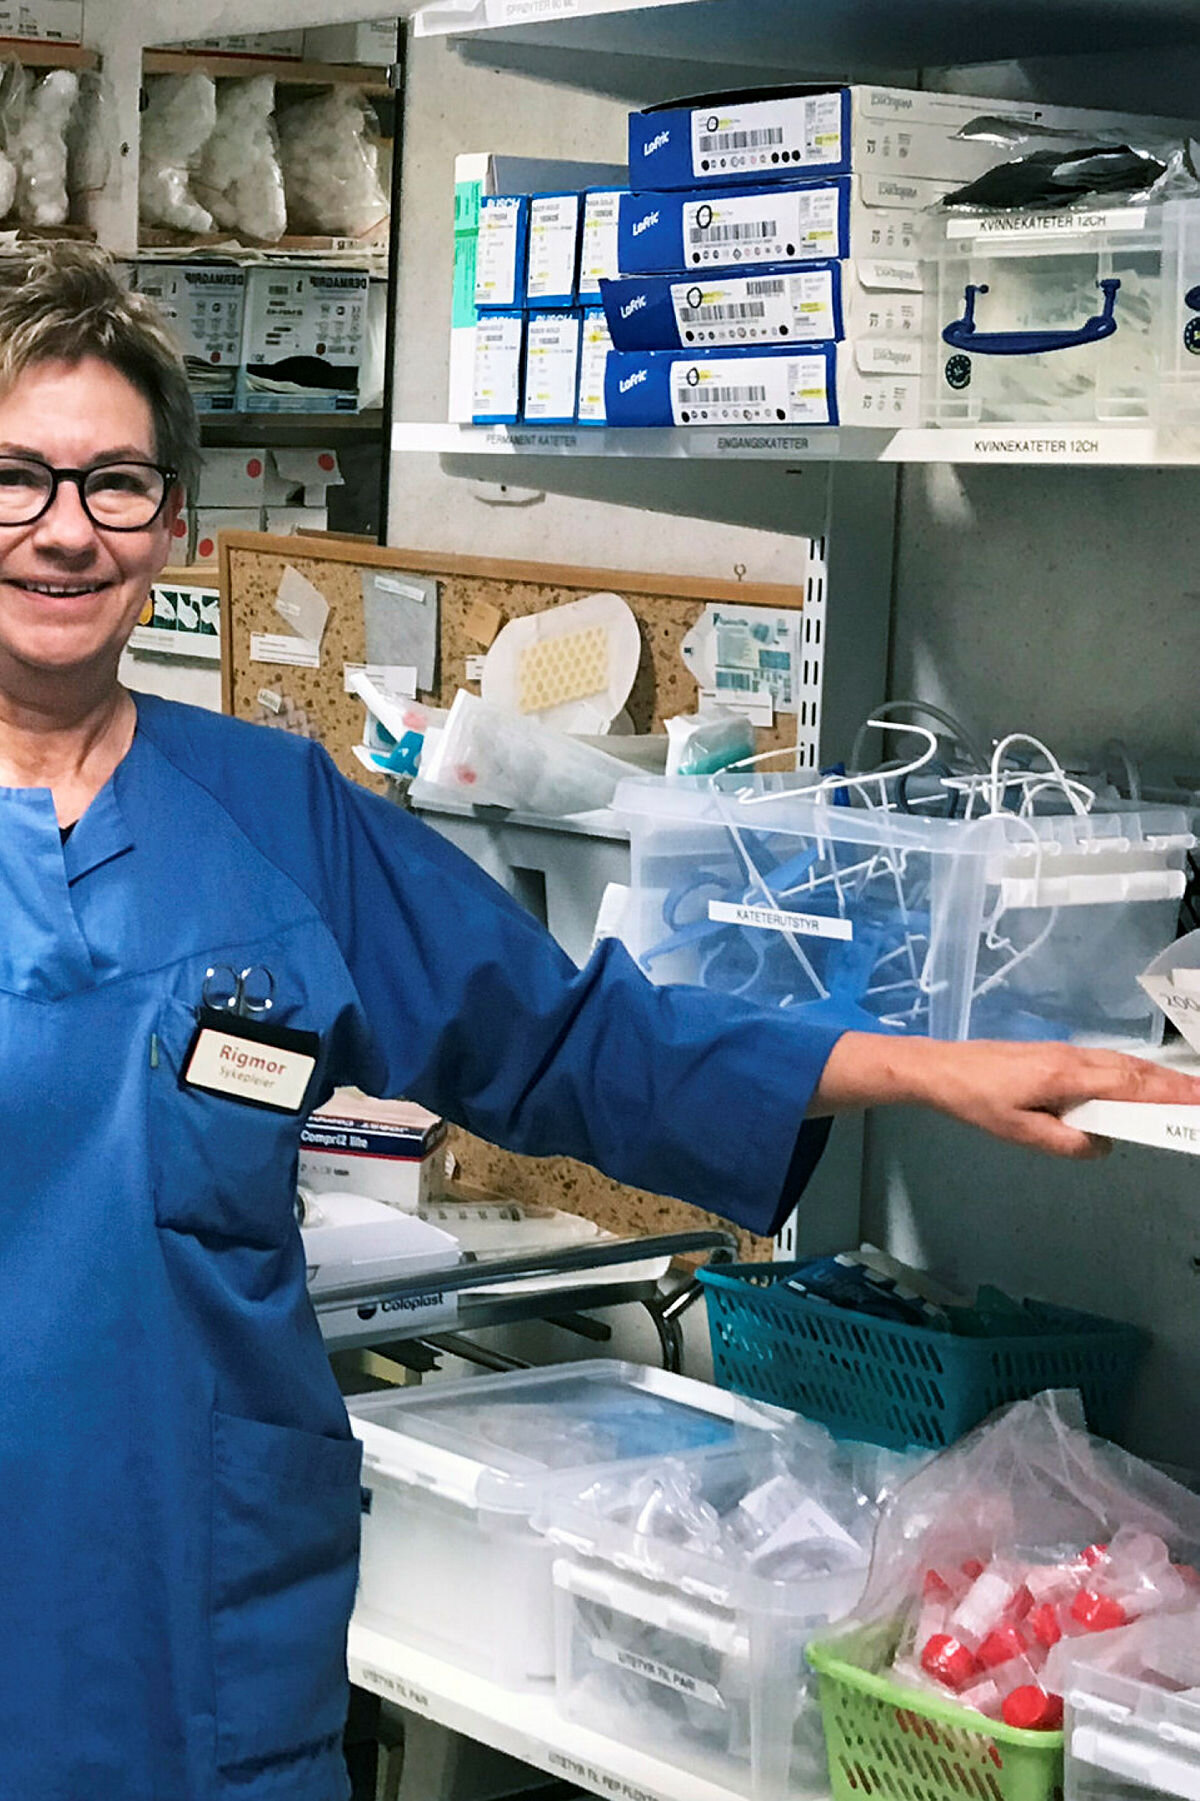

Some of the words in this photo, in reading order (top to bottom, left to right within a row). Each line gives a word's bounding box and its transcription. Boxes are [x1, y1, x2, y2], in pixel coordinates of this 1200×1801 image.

[980, 216, 1072, 232] KVINNEKATETER
[1078, 216, 1106, 227] 12CH
[486, 434, 536, 446] PERMANENT
[717, 437, 809, 449] ENGANGSKATETER
[974, 440, 1066, 453] KVINNEKATETER
[1070, 440, 1098, 453] 12CH
[736, 910, 820, 931] KATETERUTSTYR
[219, 1044, 287, 1075] Rigmor
[1166, 1123, 1200, 1142] KATE
[381, 1291, 443, 1312] Coloplast
